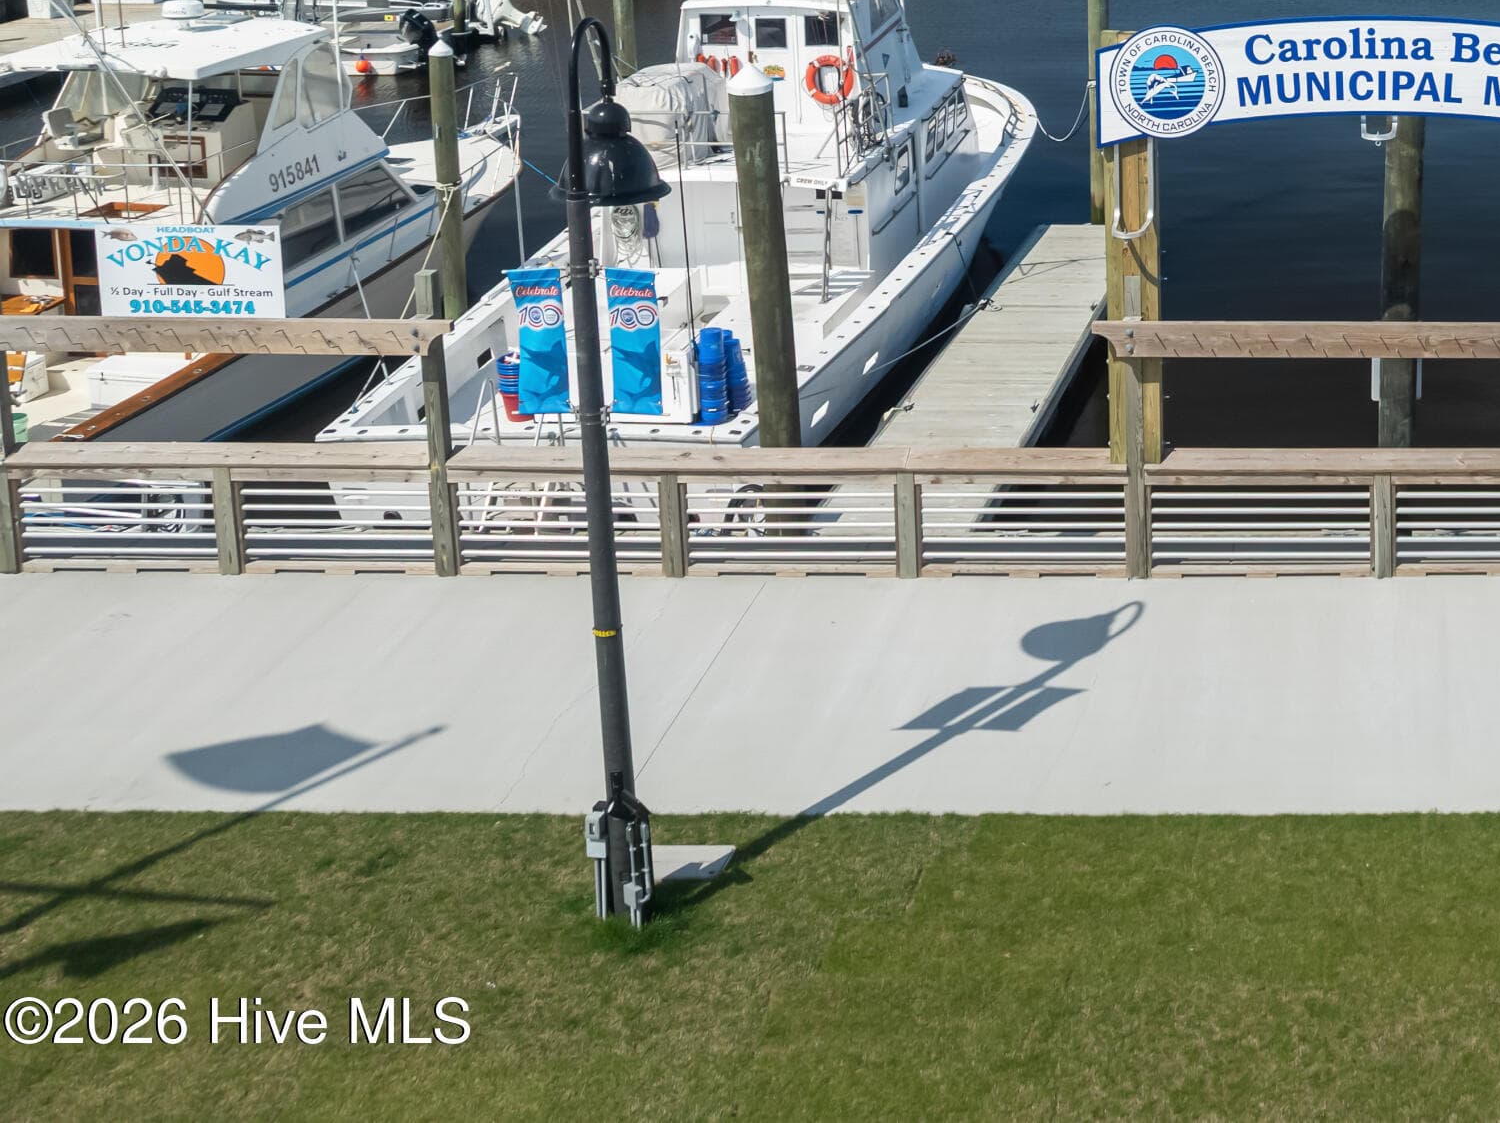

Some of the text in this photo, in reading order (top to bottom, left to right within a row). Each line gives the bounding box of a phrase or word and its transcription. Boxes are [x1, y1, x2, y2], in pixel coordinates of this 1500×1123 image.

[1244, 27, 1435, 65] Carolina
[1118, 34, 1217, 95] TOWN OF CAROLINA BEACH
[1236, 70, 1463, 107] MUNICIPAL
[1124, 102, 1213, 131] NORTH CAROLINA
[267, 153, 321, 194] 915841
[156, 226, 216, 234] HEADBOAT
[106, 235, 273, 271] VONDA KAY
[123, 287, 144, 298] Day
[153, 287, 173, 296] Full
[176, 287, 198, 298] Day
[207, 288, 231, 297] Gulf
[233, 289, 273, 297] Stream
[515, 284, 559, 298] Celebrate
[609, 284, 654, 298] Celebrate
[129, 299, 256, 315] 910-545-3474
[519, 305, 563, 328] 100
[609, 305, 658, 329] 100
